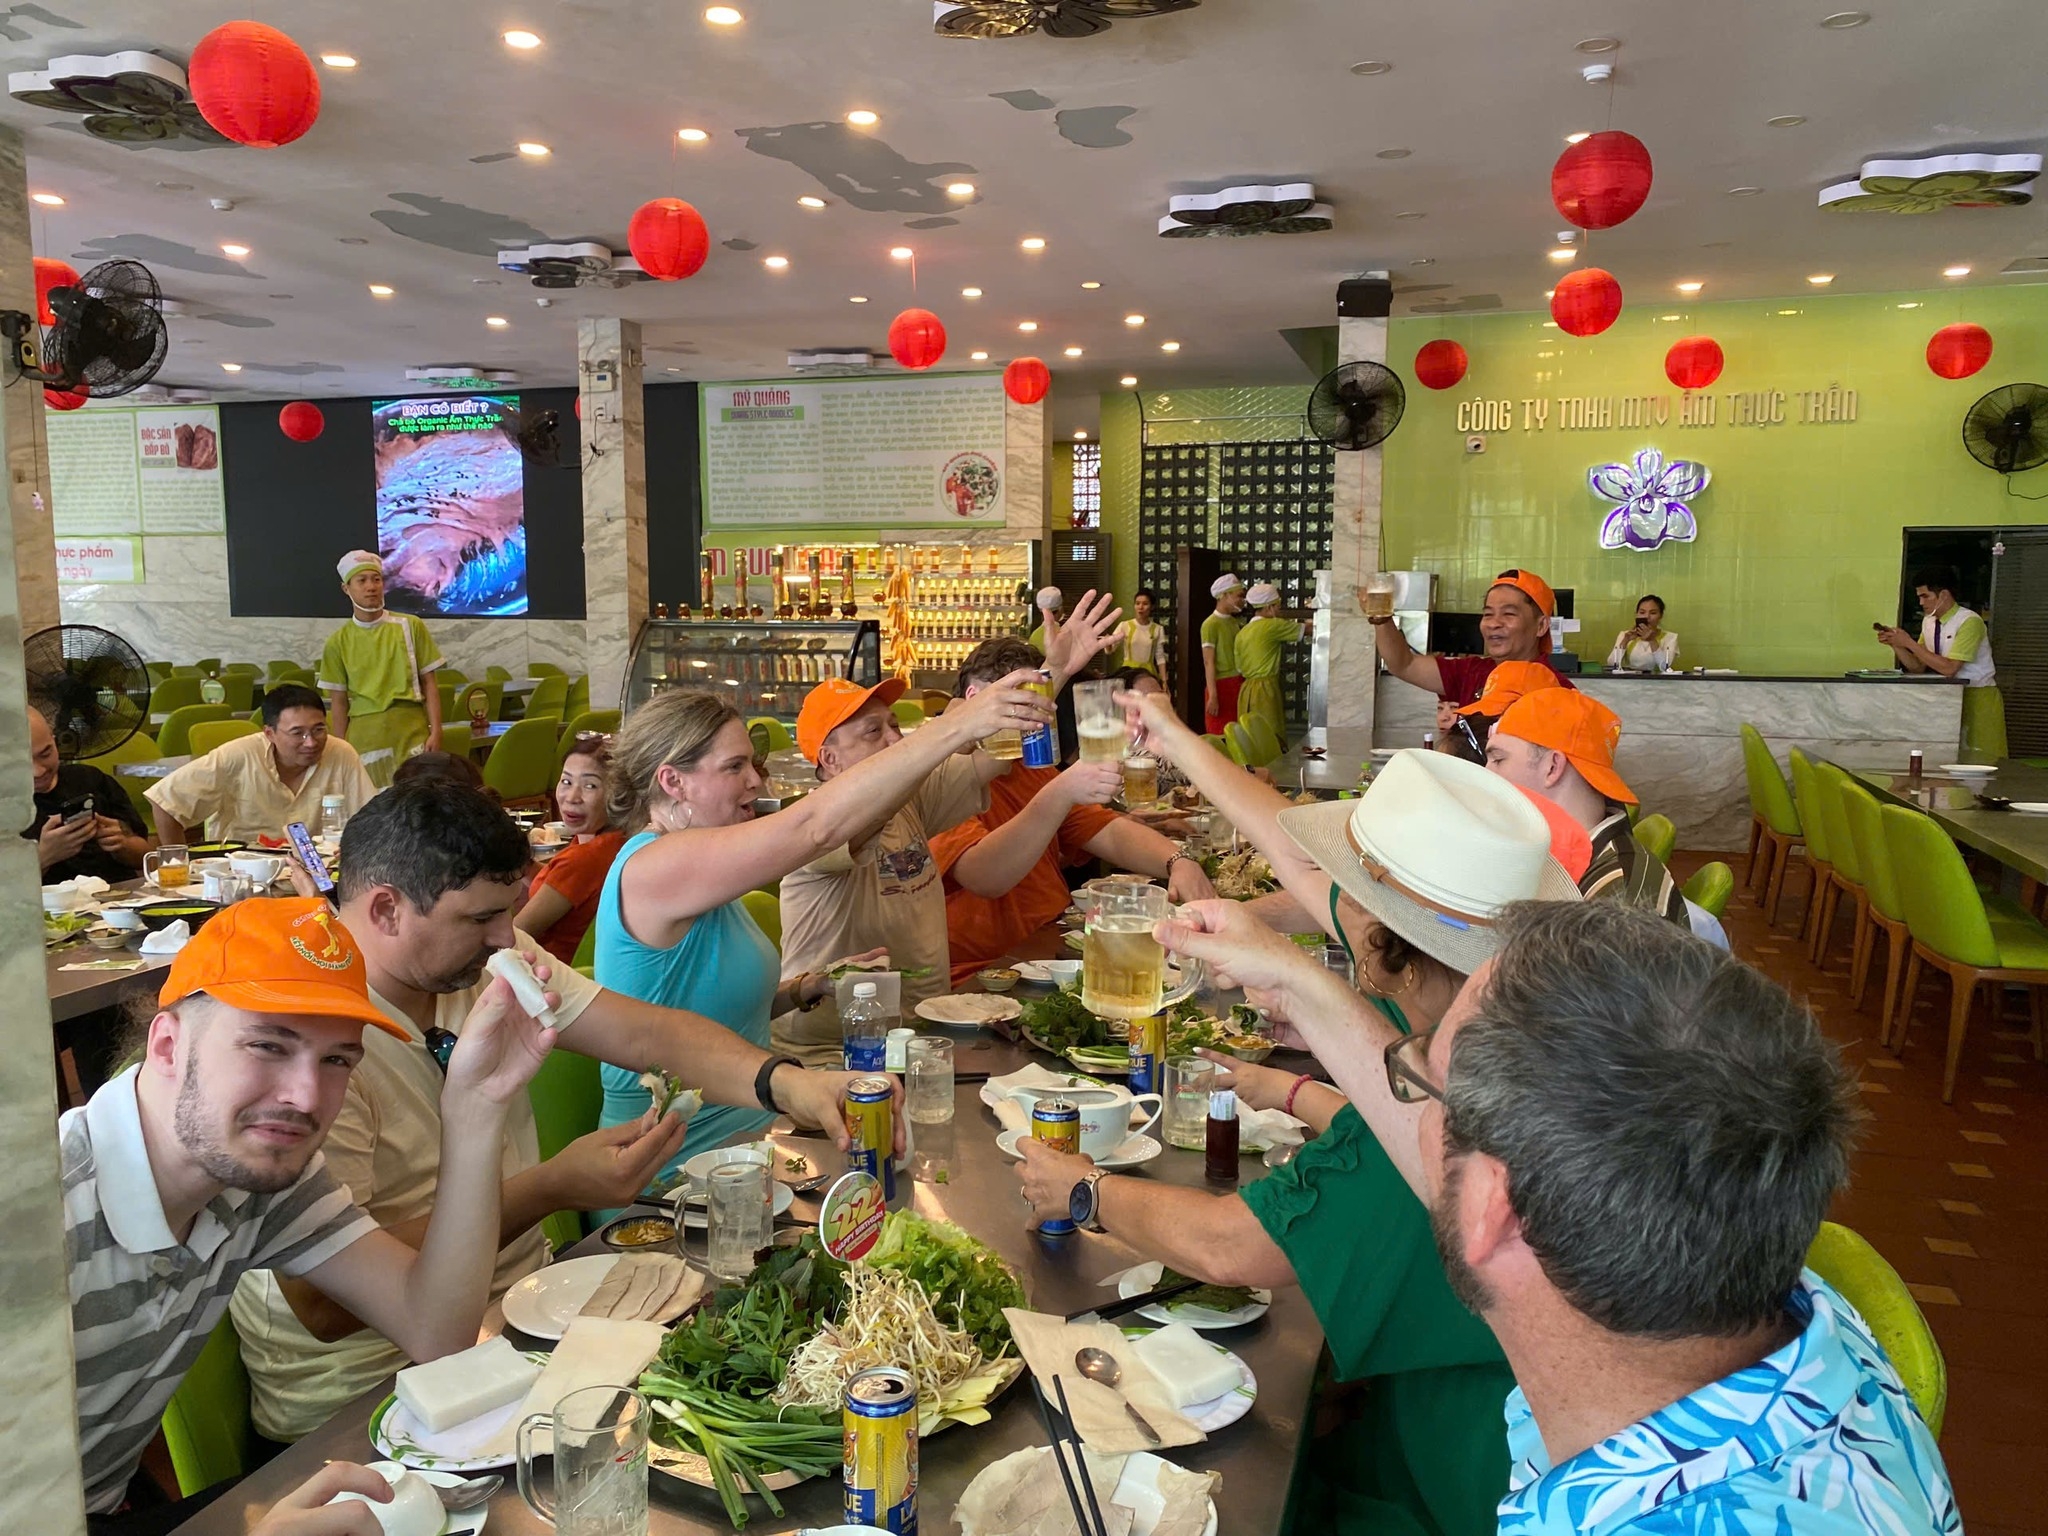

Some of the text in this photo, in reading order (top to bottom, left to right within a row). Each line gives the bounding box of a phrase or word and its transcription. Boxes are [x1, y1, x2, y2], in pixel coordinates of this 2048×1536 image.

[754, 387, 791, 407] QUẢNG
[402, 403, 429, 418] BẠN
[430, 402, 450, 415] CÓ
[451, 399, 478, 414] BIẾT
[1457, 397, 1512, 432] CÔNG
[1521, 398, 1549, 430] TY
[1557, 396, 1613, 429] TNHH
[1619, 395, 1669, 427] MTV
[1726, 388, 1787, 429] THỰC
[417, 416, 448, 425] Organic
[79, 542, 114, 560] phẩm
[829, 1186, 877, 1240] 22
[835, 1231, 855, 1255] HAPPY
[854, 1209, 885, 1237] BIRTHDAY
